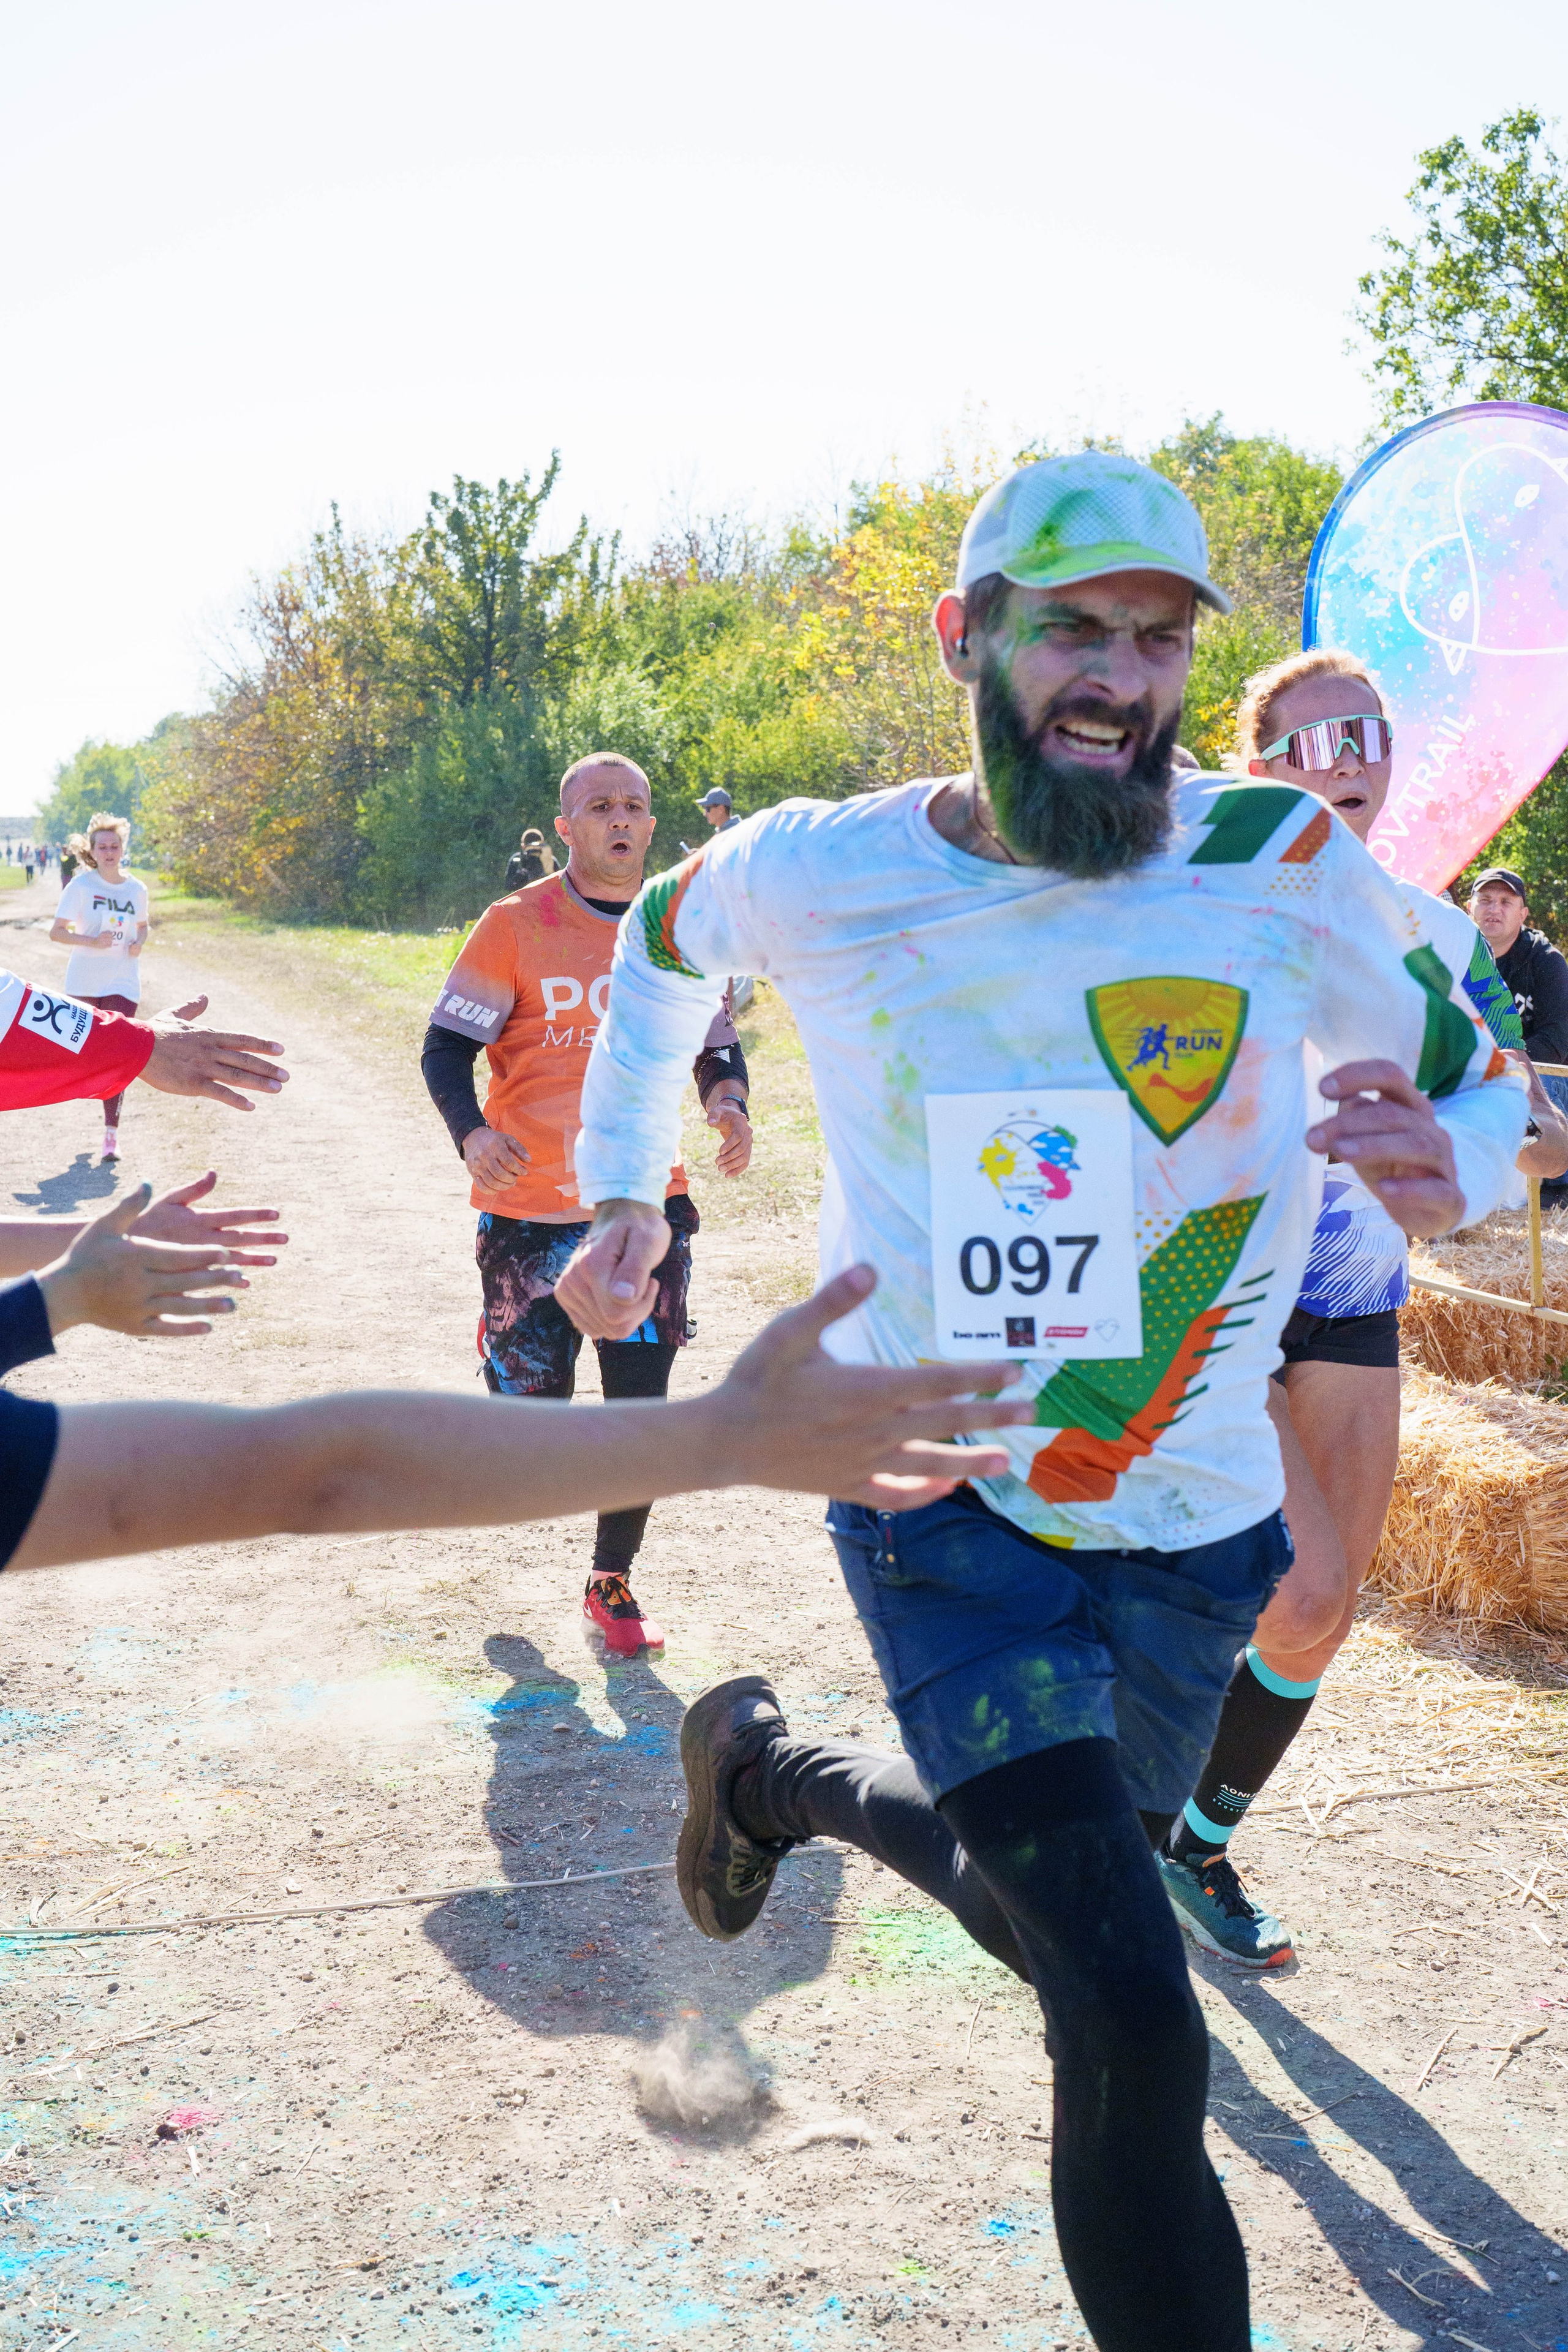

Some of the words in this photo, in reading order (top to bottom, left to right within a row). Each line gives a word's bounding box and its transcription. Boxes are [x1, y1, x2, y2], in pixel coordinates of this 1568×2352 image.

[93, 895, 135, 914] FILA
[444, 994, 499, 1028] RUN
[1175, 1036, 1222, 1050] RUN
[959, 1235, 1099, 1296] 097
